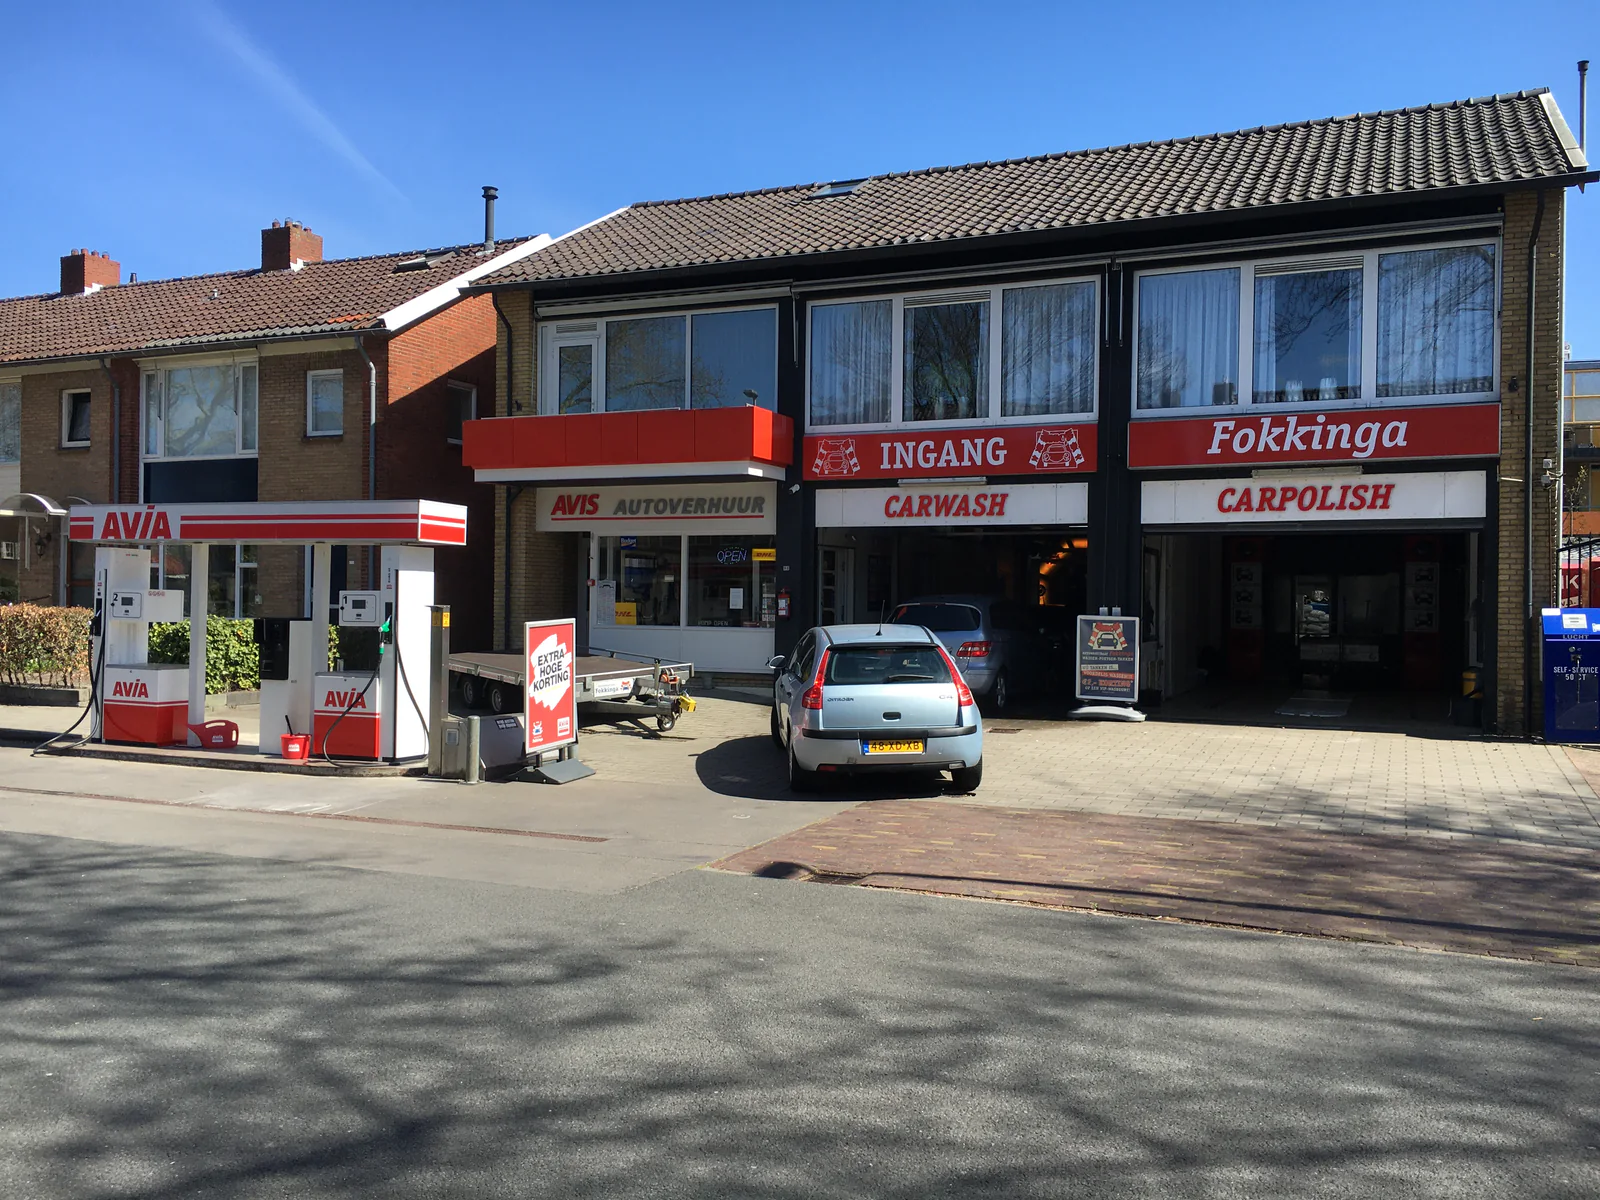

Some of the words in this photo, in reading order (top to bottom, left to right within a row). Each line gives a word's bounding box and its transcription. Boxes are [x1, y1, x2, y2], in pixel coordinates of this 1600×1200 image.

[1207, 414, 1408, 458] Fokkinga
[880, 437, 1007, 469] INGANG
[551, 494, 600, 515] AVIS
[612, 496, 765, 516] AUTOVERHUUR
[884, 493, 1009, 518] CARWASH
[1217, 484, 1395, 513] CARPOLISH
[101, 505, 172, 539] AVIA
[717, 550, 747, 562] OPEN
[113, 594, 118, 602] 2
[343, 595, 348, 604] 1
[538, 648, 565, 666] EXTRA
[540, 661, 563, 678] HOGE
[112, 679, 149, 698] AVIA
[533, 670, 569, 692] KORTING
[324, 688, 367, 708] AVIA
[870, 740, 920, 751] 48-XD-XB
